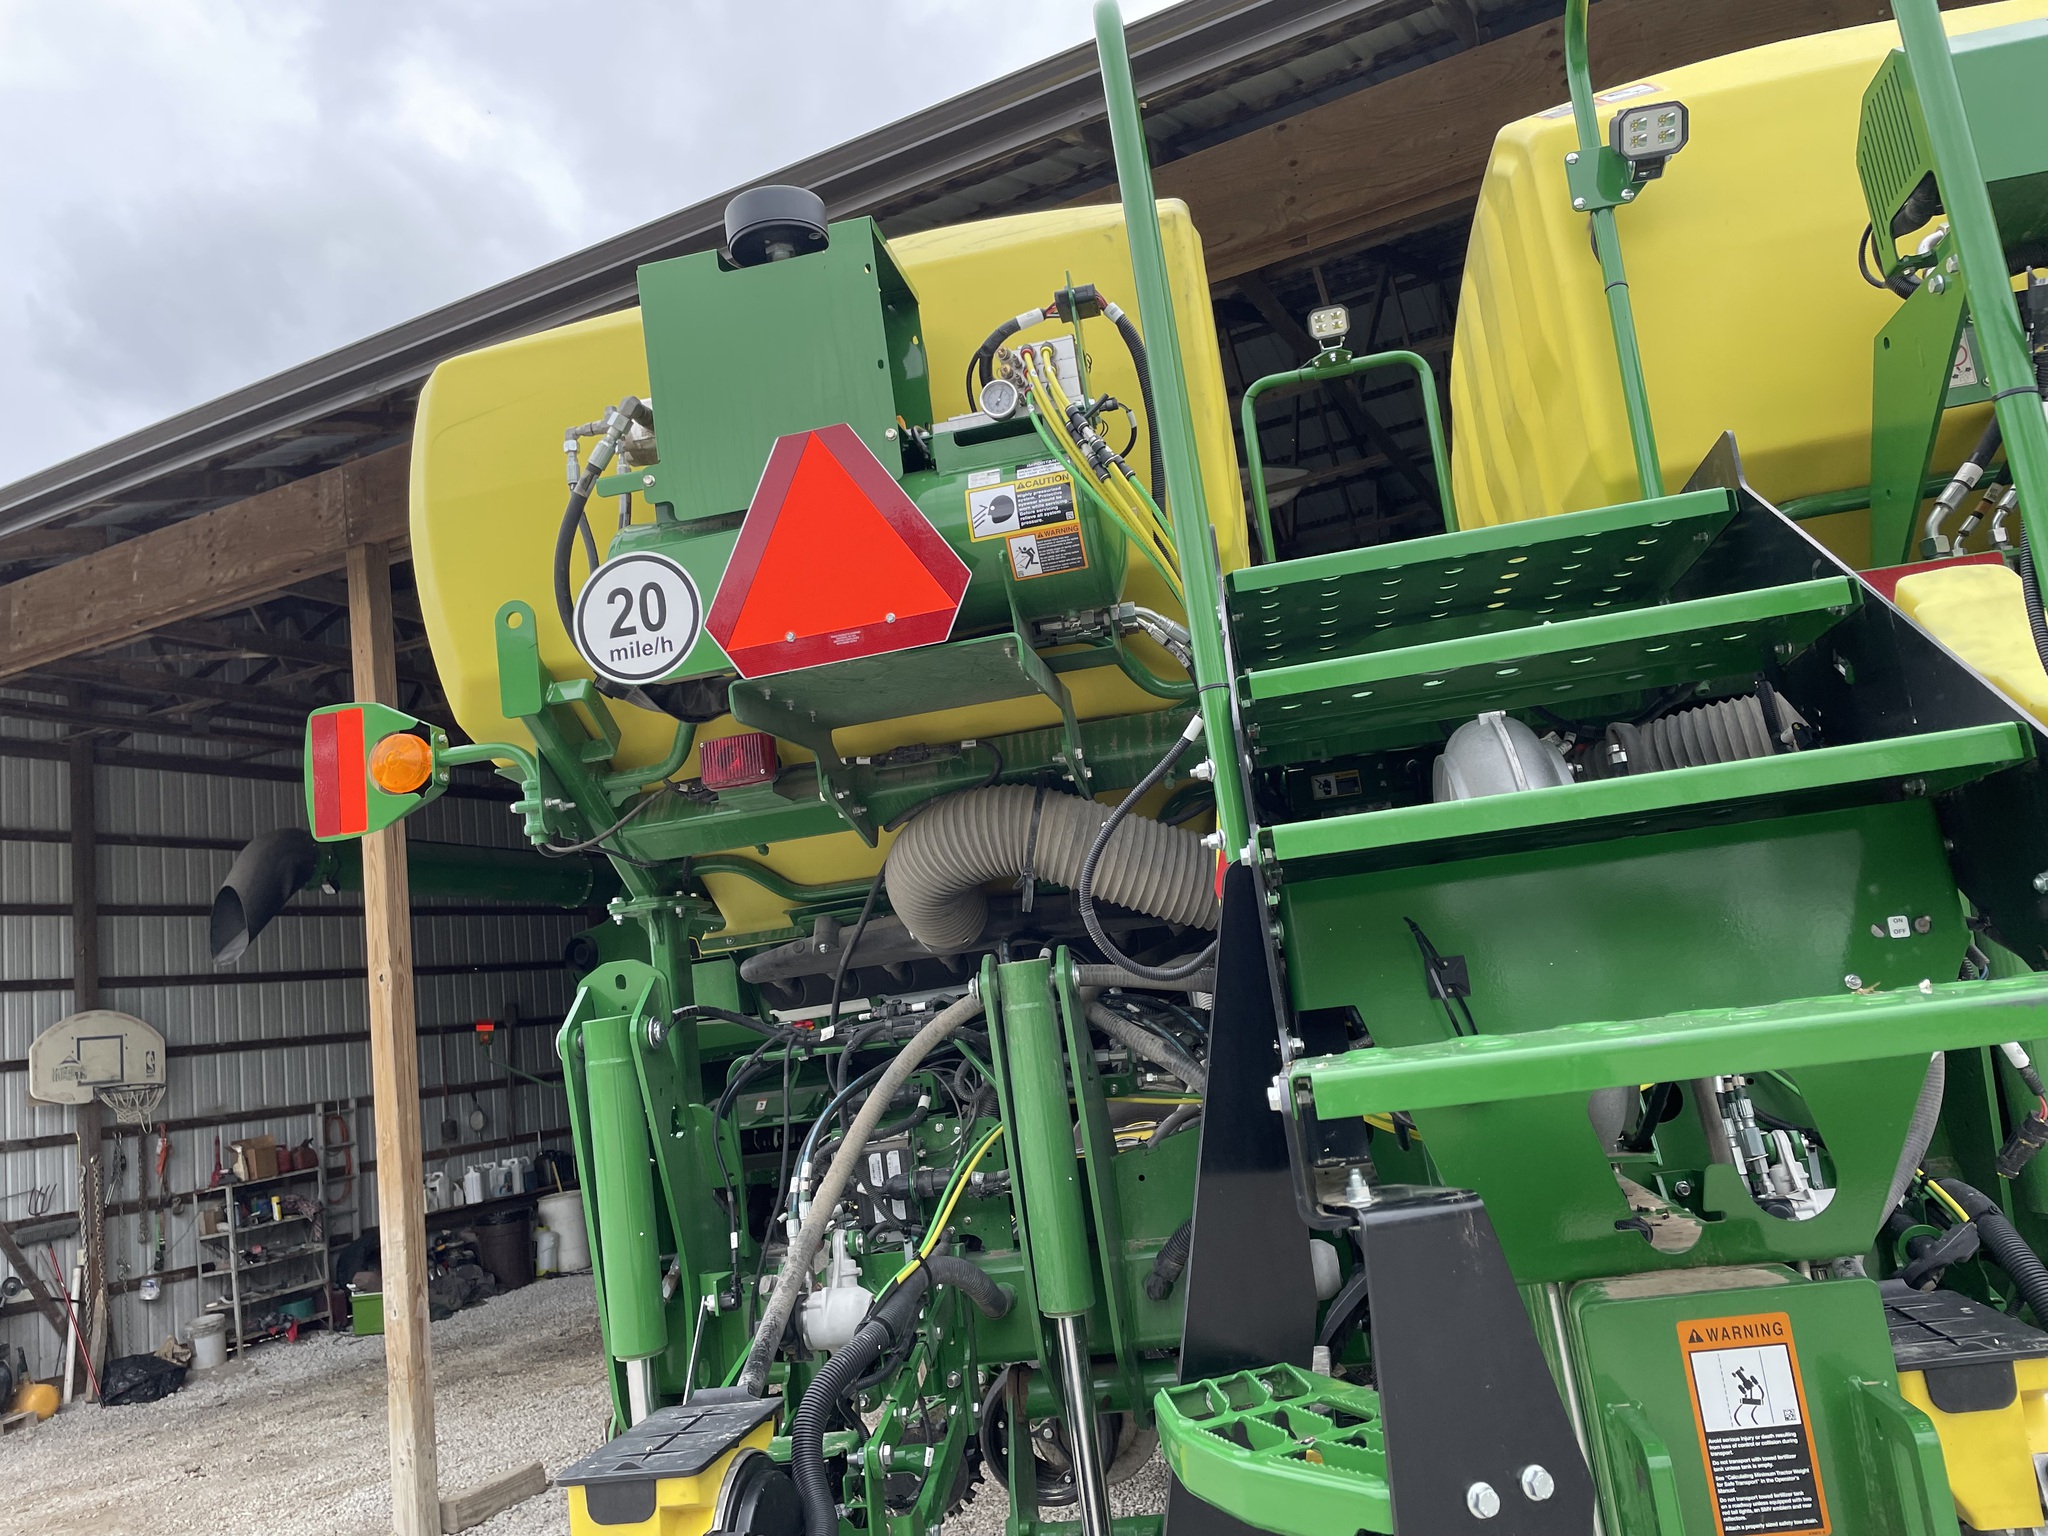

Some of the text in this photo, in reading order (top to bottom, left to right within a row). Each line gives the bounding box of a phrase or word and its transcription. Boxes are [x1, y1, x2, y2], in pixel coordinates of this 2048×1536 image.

[1026, 458, 1059, 468] IMPORTAN
[1024, 473, 1070, 488] CAUTION
[1033, 486, 1062, 496] pressurized
[1036, 506, 1058, 514] servicing
[1020, 518, 1044, 526] pressure.
[1044, 525, 1079, 537] WARNING
[606, 581, 667, 639] 20
[610, 636, 674, 662] mile/h
[1705, 1322, 1784, 1342] WARNING
[1740, 1434, 1754, 1442] injury
[1736, 1494, 1758, 1502] transport
[1769, 1498, 1792, 1506] equipped
[1746, 1522, 1766, 1530] properly
